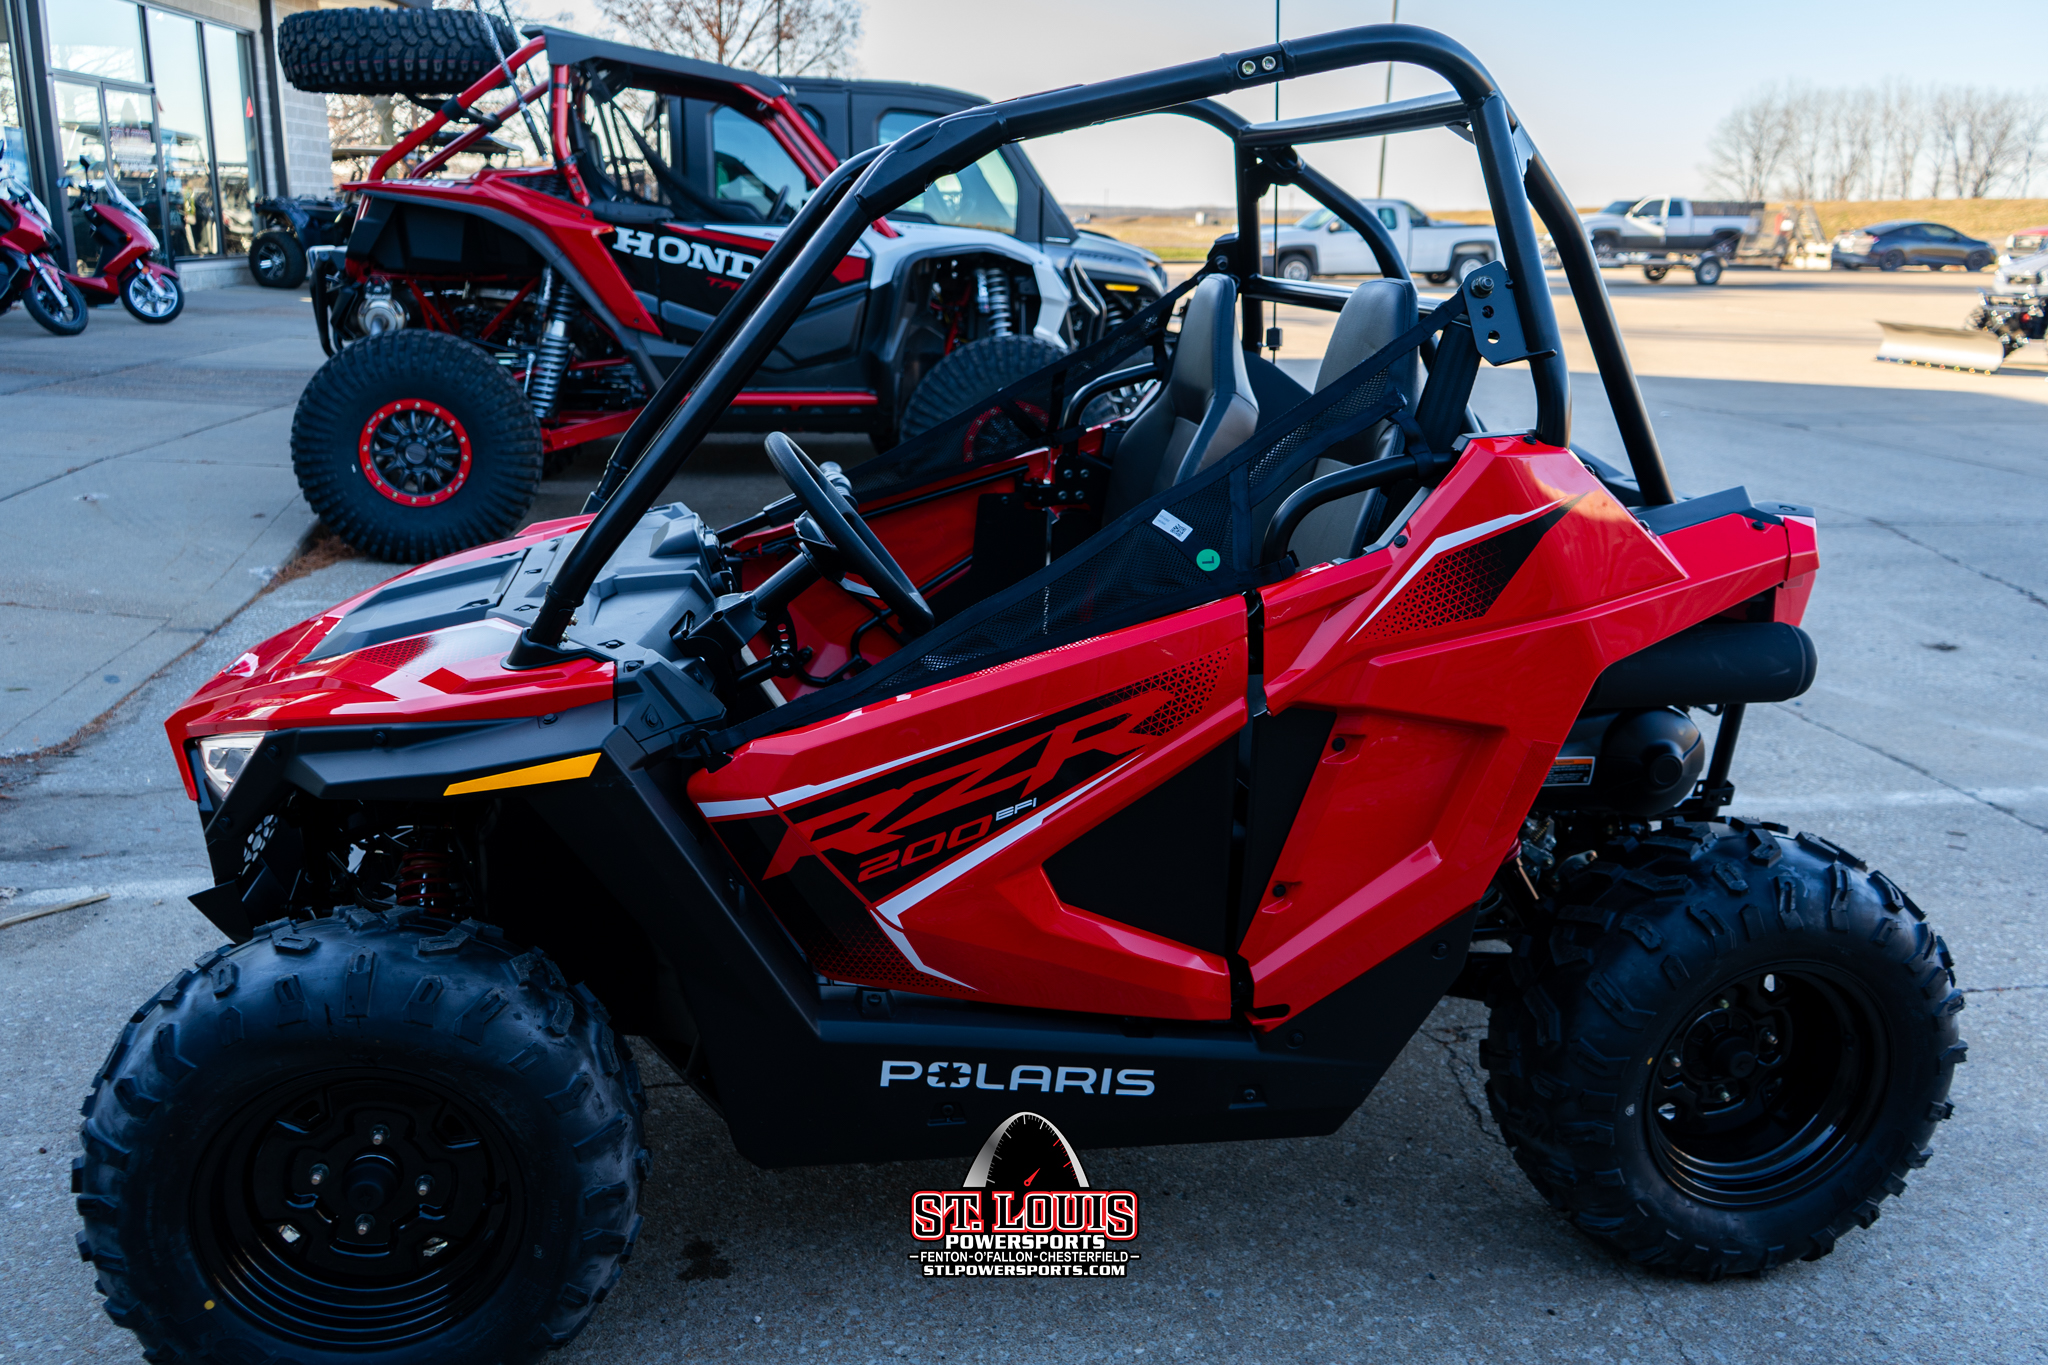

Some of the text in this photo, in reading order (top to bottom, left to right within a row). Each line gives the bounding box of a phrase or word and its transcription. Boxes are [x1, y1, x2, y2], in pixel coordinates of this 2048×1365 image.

[612, 226, 762, 280] HOND
[762, 689, 1178, 881] RZR
[857, 796, 1037, 882] 200 EFI
[880, 1060, 1156, 1097] POLARIS
